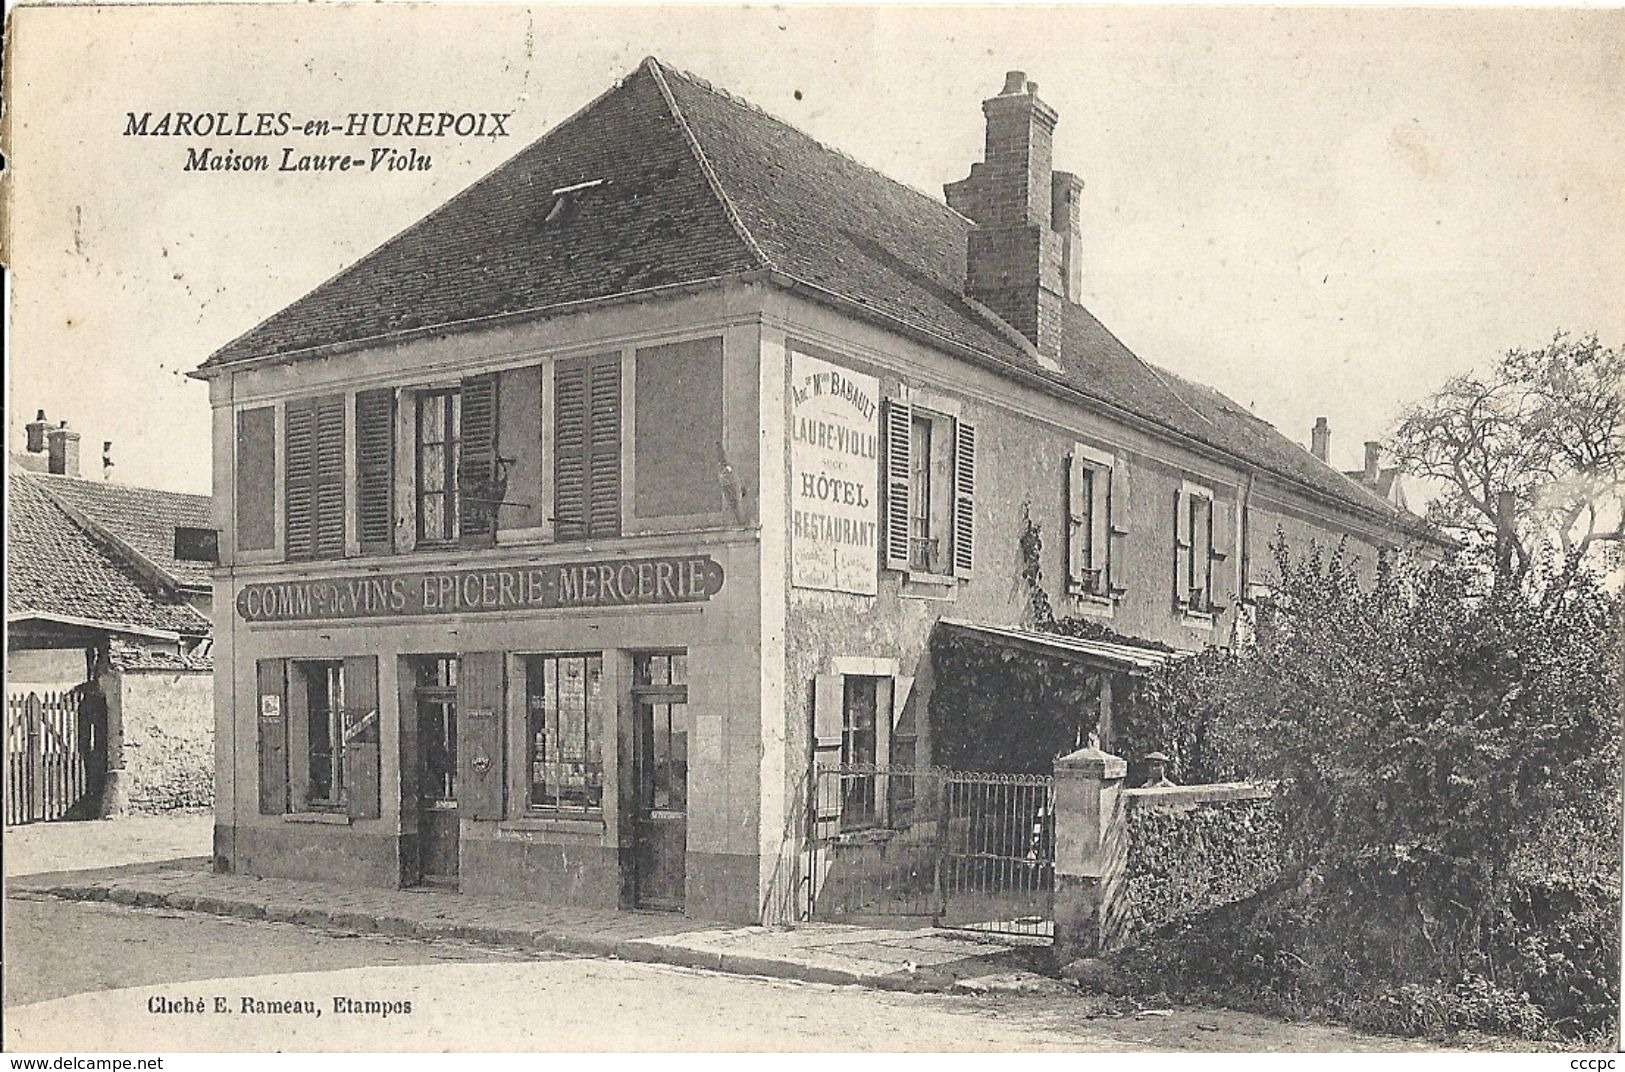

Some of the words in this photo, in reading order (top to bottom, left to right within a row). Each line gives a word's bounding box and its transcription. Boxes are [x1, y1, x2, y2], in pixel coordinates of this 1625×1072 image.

[831, 371, 876, 422] BABAULT
[793, 415, 876, 459] LAURE-VIOLU
[801, 471, 869, 508] HÔTEL
[794, 509, 876, 548] RESTAURANT
[347, 578, 407, 614] VINS
[422, 570, 544, 610] EPICERIE
[557, 559, 705, 602] MERCERIE
